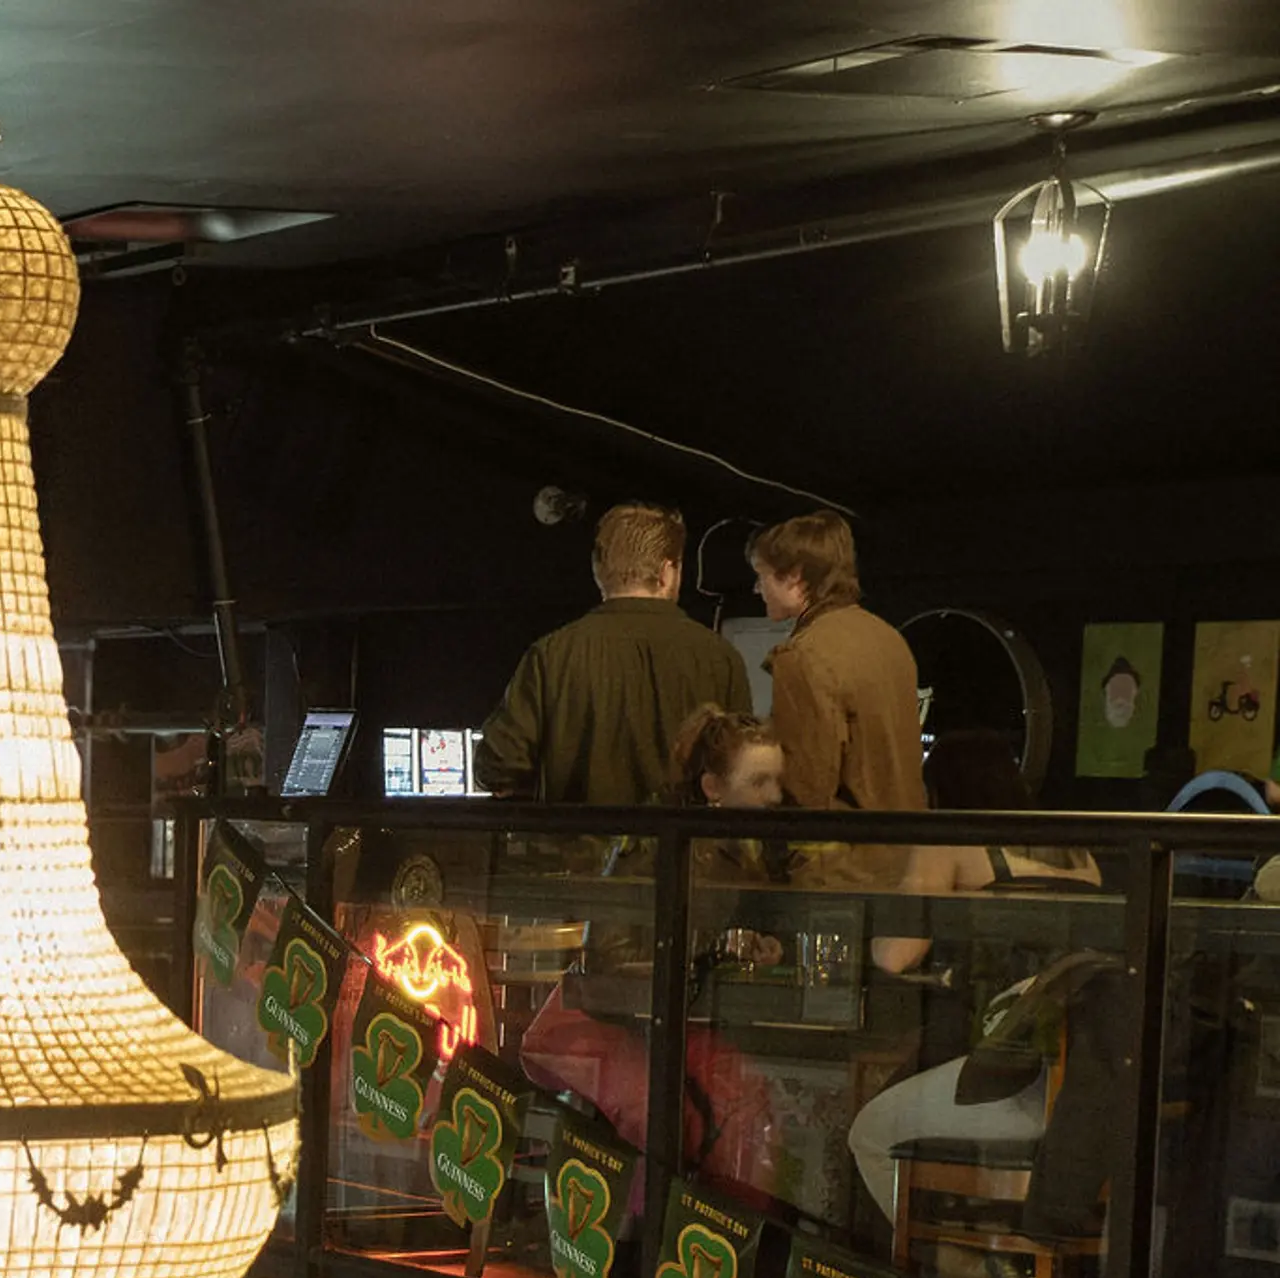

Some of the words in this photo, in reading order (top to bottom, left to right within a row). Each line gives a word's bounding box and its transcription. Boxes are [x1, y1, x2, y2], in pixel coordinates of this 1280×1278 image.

[264, 995, 310, 1047] GUINNESS
[354, 1075, 409, 1123] GUINNESS
[437, 1152, 485, 1202] GUINNESS
[694, 1198, 732, 1230] PATRICK'S
[731, 1221, 750, 1239] DAY
[550, 1229, 597, 1276] GUINNESS
